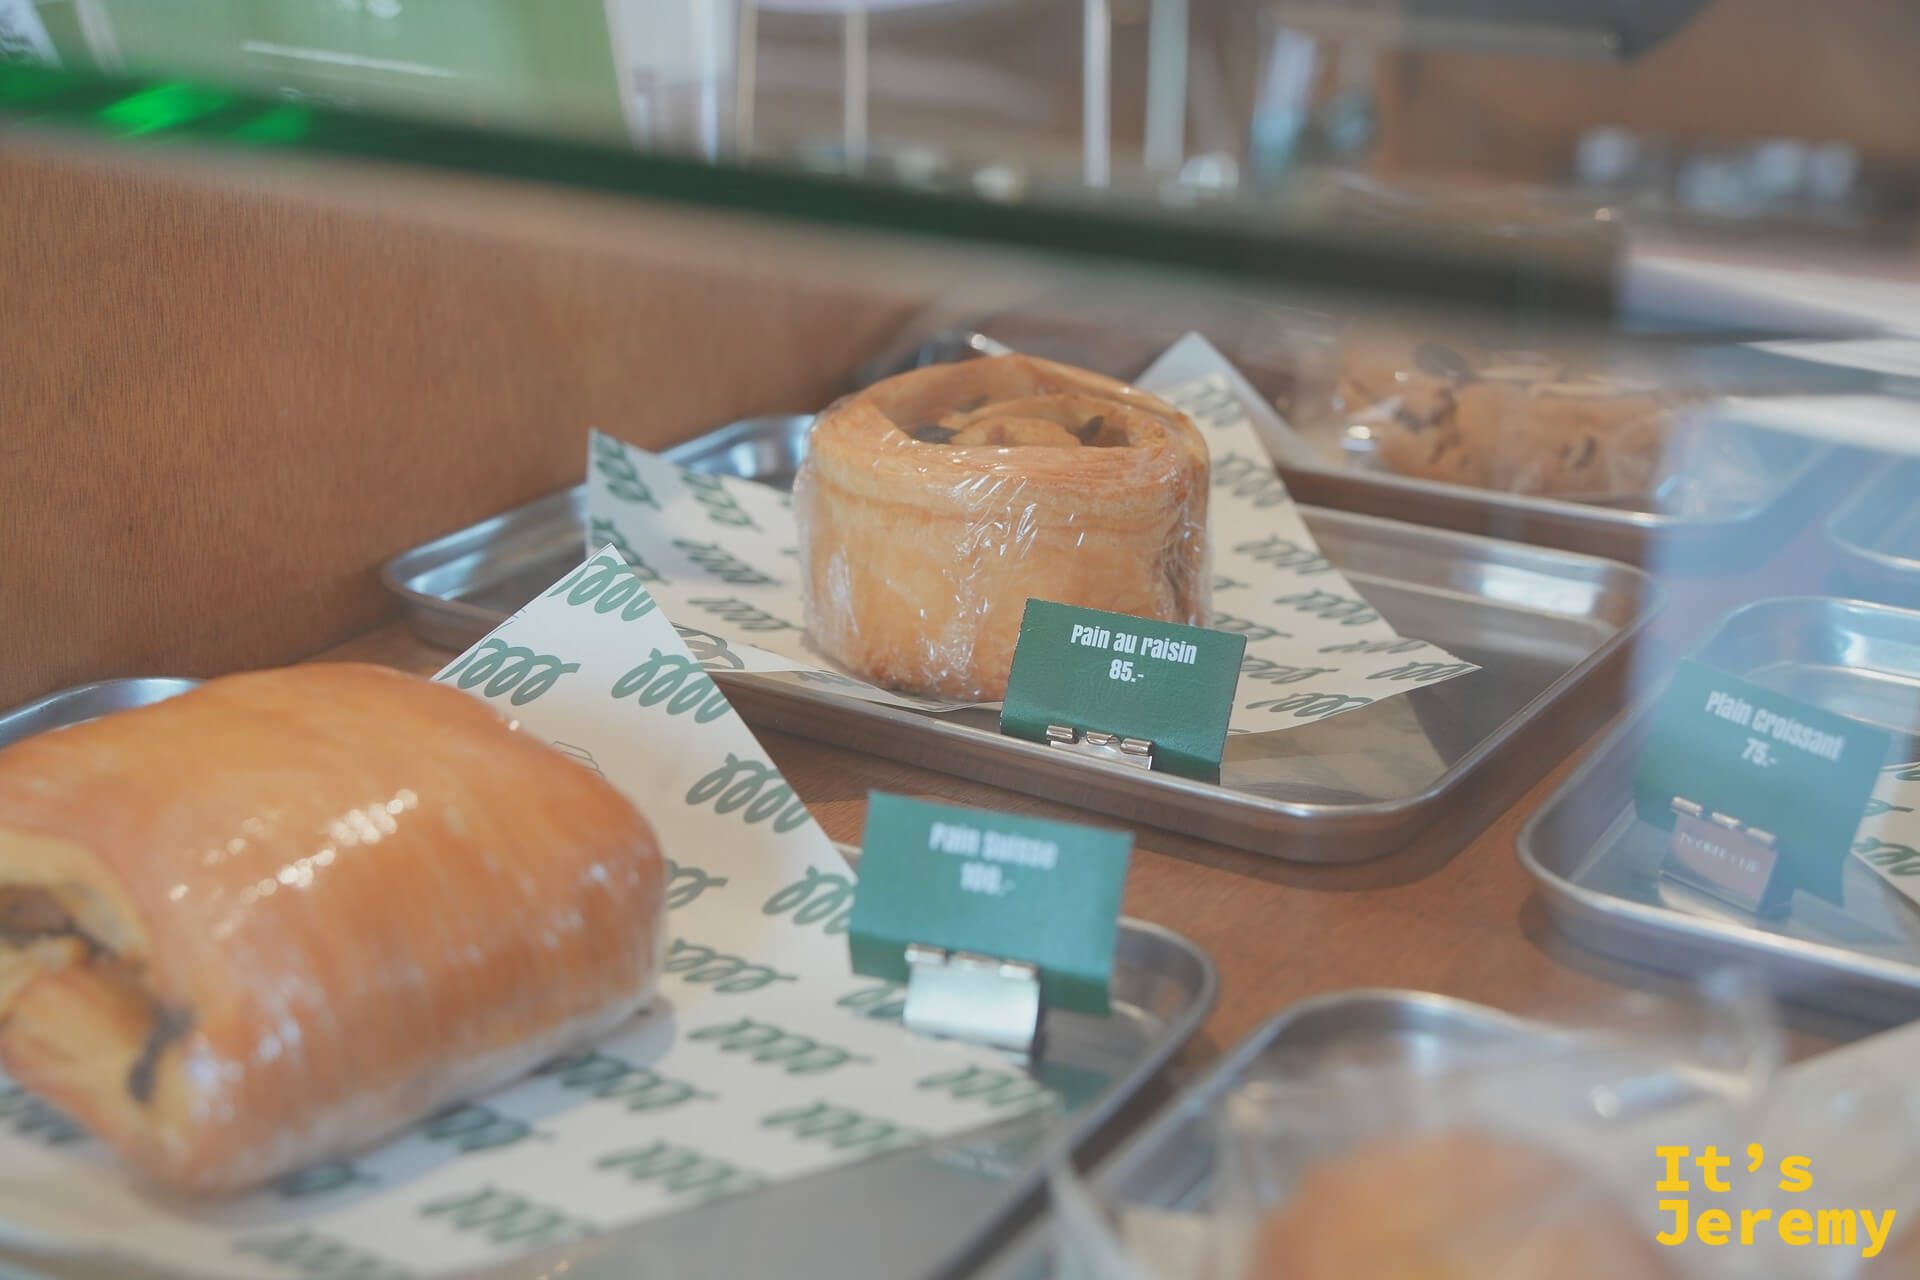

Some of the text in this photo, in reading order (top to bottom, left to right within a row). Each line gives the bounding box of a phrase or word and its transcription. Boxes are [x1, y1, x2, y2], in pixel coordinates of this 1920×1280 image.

[1070, 624, 1198, 665] Pain au raisin
[1109, 659, 1144, 683] 85.-
[1704, 690, 1845, 762] Plain Croissant
[928, 821, 1058, 870] Pain Suisse
